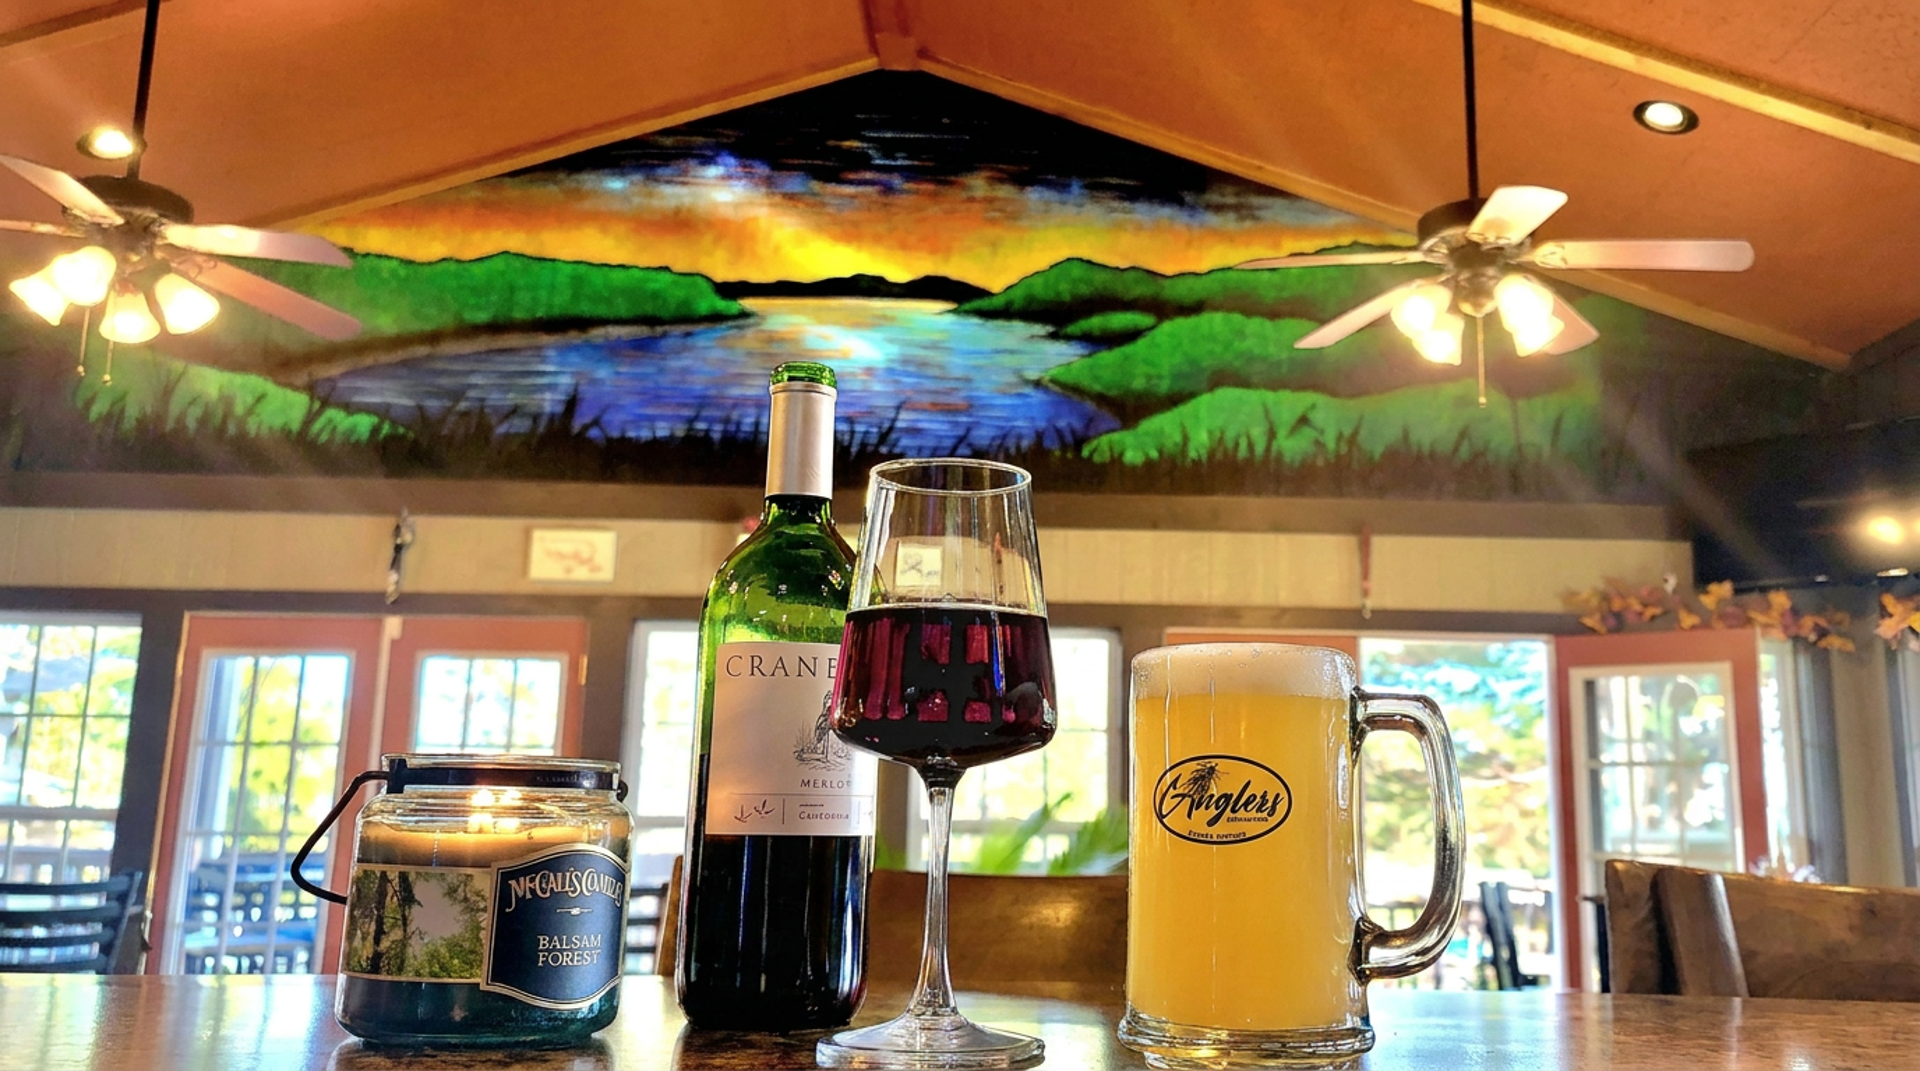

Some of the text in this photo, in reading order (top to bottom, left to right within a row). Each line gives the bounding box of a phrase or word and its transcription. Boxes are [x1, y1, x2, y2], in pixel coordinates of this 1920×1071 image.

[1158, 773, 1284, 827] Anglers
[537, 934, 601, 950] BALSAM
[537, 949, 601, 966] FOREST
